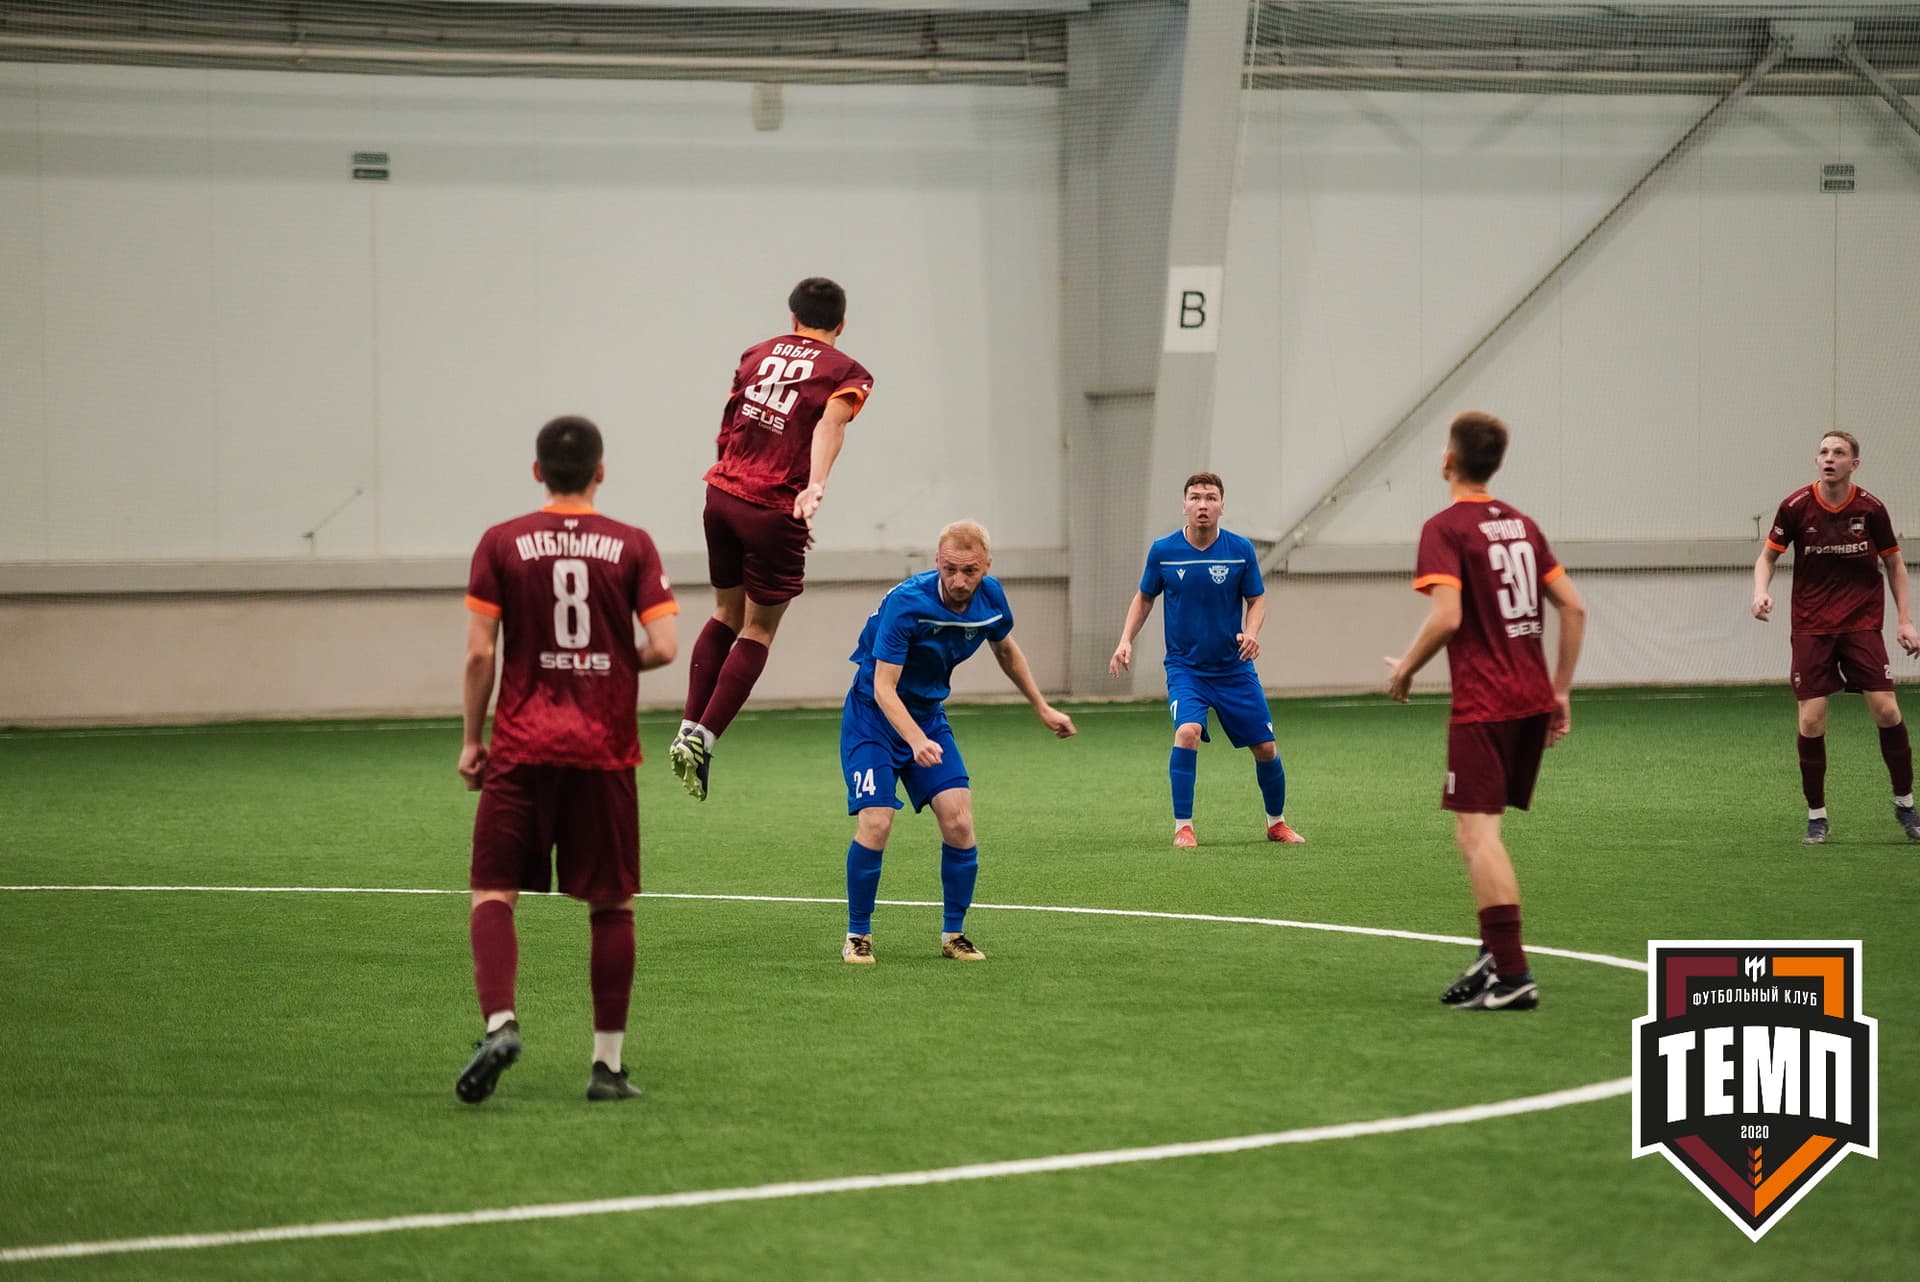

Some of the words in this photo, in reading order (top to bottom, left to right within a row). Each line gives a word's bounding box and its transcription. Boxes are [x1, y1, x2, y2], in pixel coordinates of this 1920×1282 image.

[1180, 291, 1206, 328] B
[744, 356, 814, 415] 32
[741, 403, 785, 430] SEUS
[515, 530, 624, 564] ЩЕБЛЫКИН
[1488, 541, 1538, 619] 30
[553, 559, 591, 649] 8
[540, 652, 611, 670] SEUS
[853, 768, 876, 799] 24
